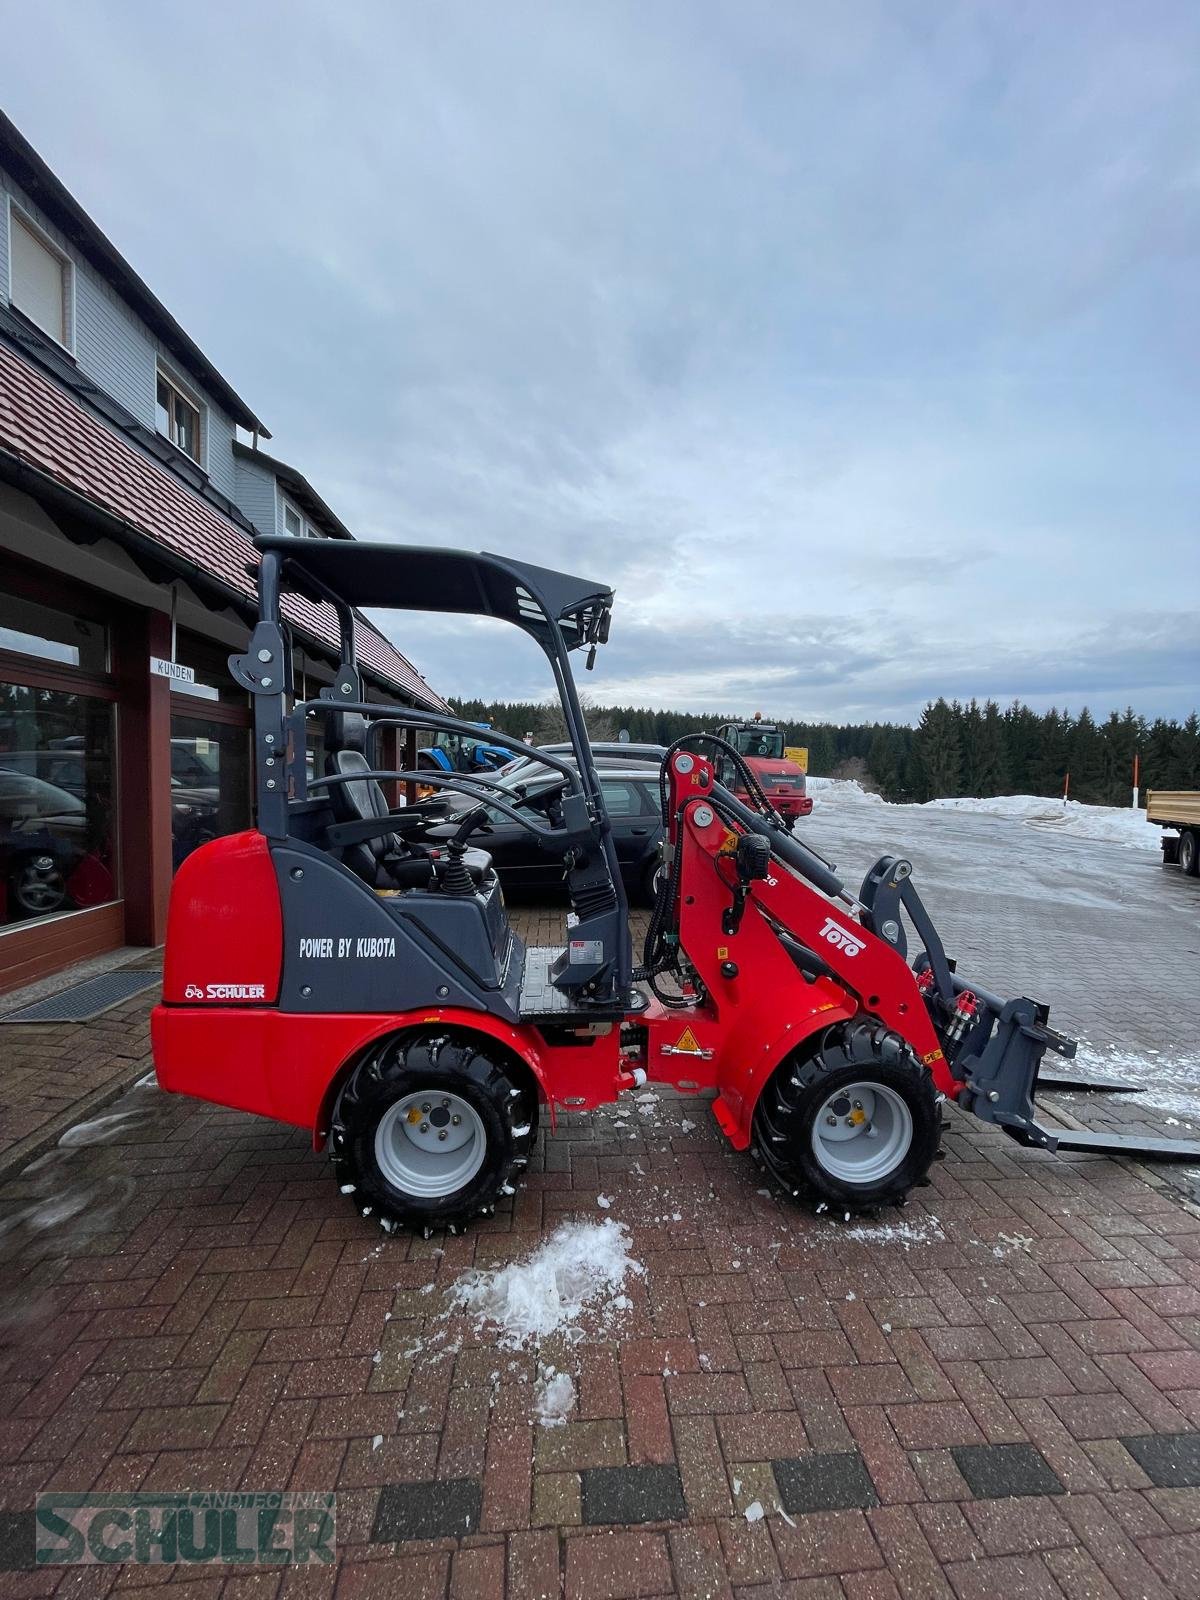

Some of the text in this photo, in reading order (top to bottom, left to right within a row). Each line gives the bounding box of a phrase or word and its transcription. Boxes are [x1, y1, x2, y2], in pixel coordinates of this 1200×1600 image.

[157, 660, 192, 681] KUNDEN
[818, 916, 867, 957] TOYO
[299, 937, 396, 958] POWER BY KUBOTA
[206, 984, 265, 999] SCHULER
